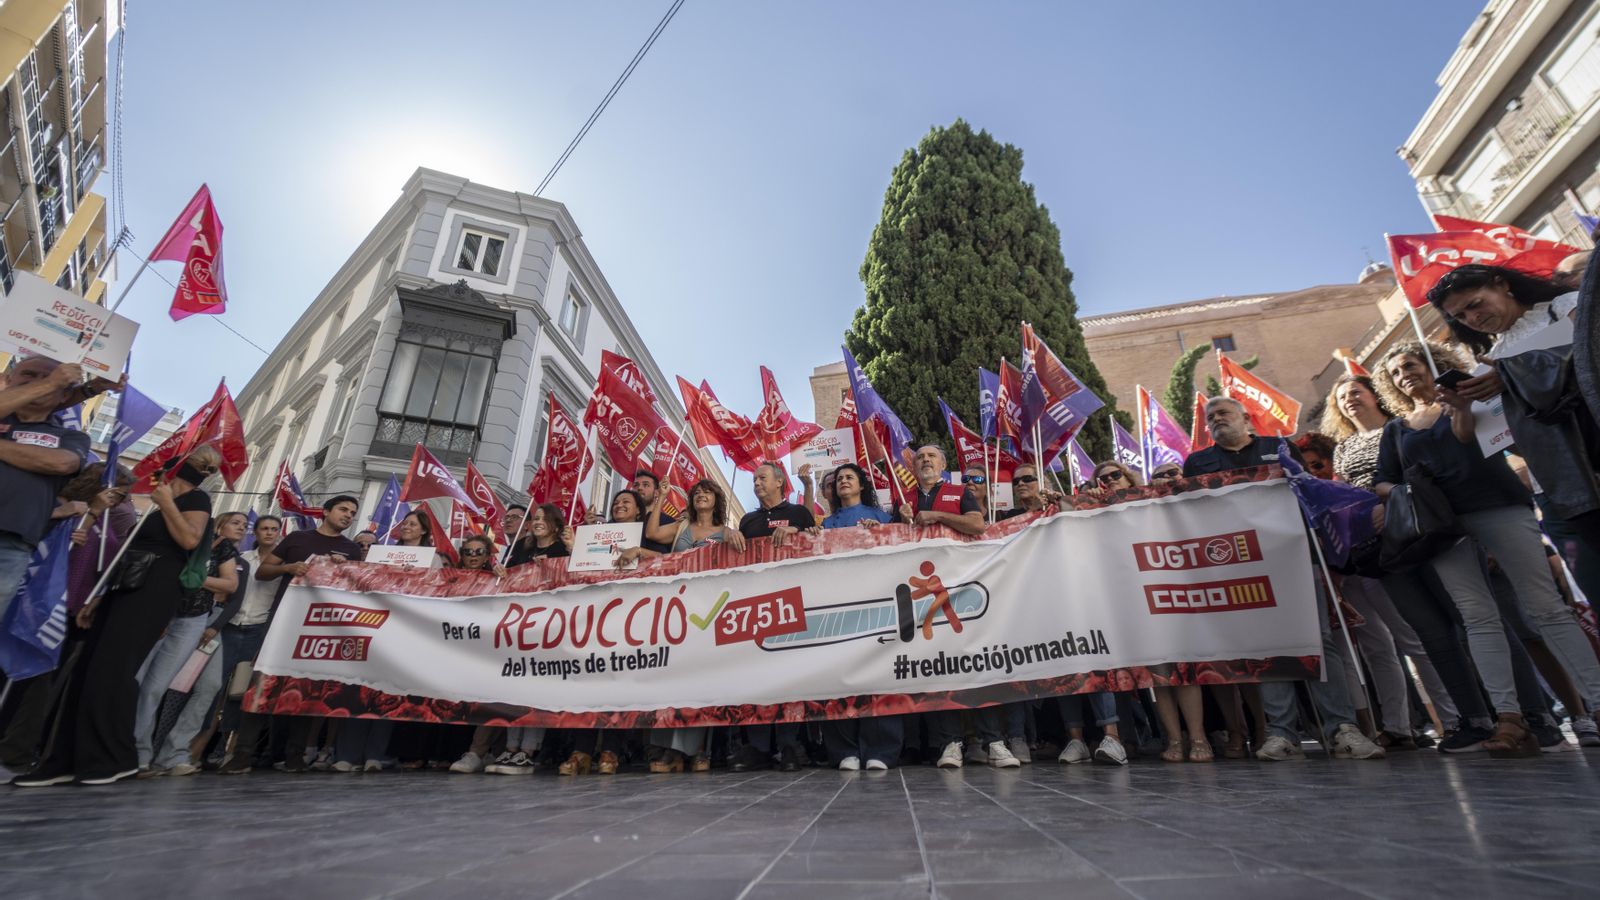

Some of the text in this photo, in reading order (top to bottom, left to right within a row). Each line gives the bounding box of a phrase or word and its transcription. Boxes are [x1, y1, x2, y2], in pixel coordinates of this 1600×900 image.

[1144, 542, 1200, 569] UGT
[1152, 586, 1231, 609] CCOO
[308, 607, 360, 623] CCOO
[442, 585, 688, 651] Per la REDUCCIÓ
[722, 597, 798, 636] 37,5 h
[300, 638, 341, 659] UGT
[501, 646, 671, 681] del temps de treball
[893, 629, 1111, 681] #reducciójornadaJA
